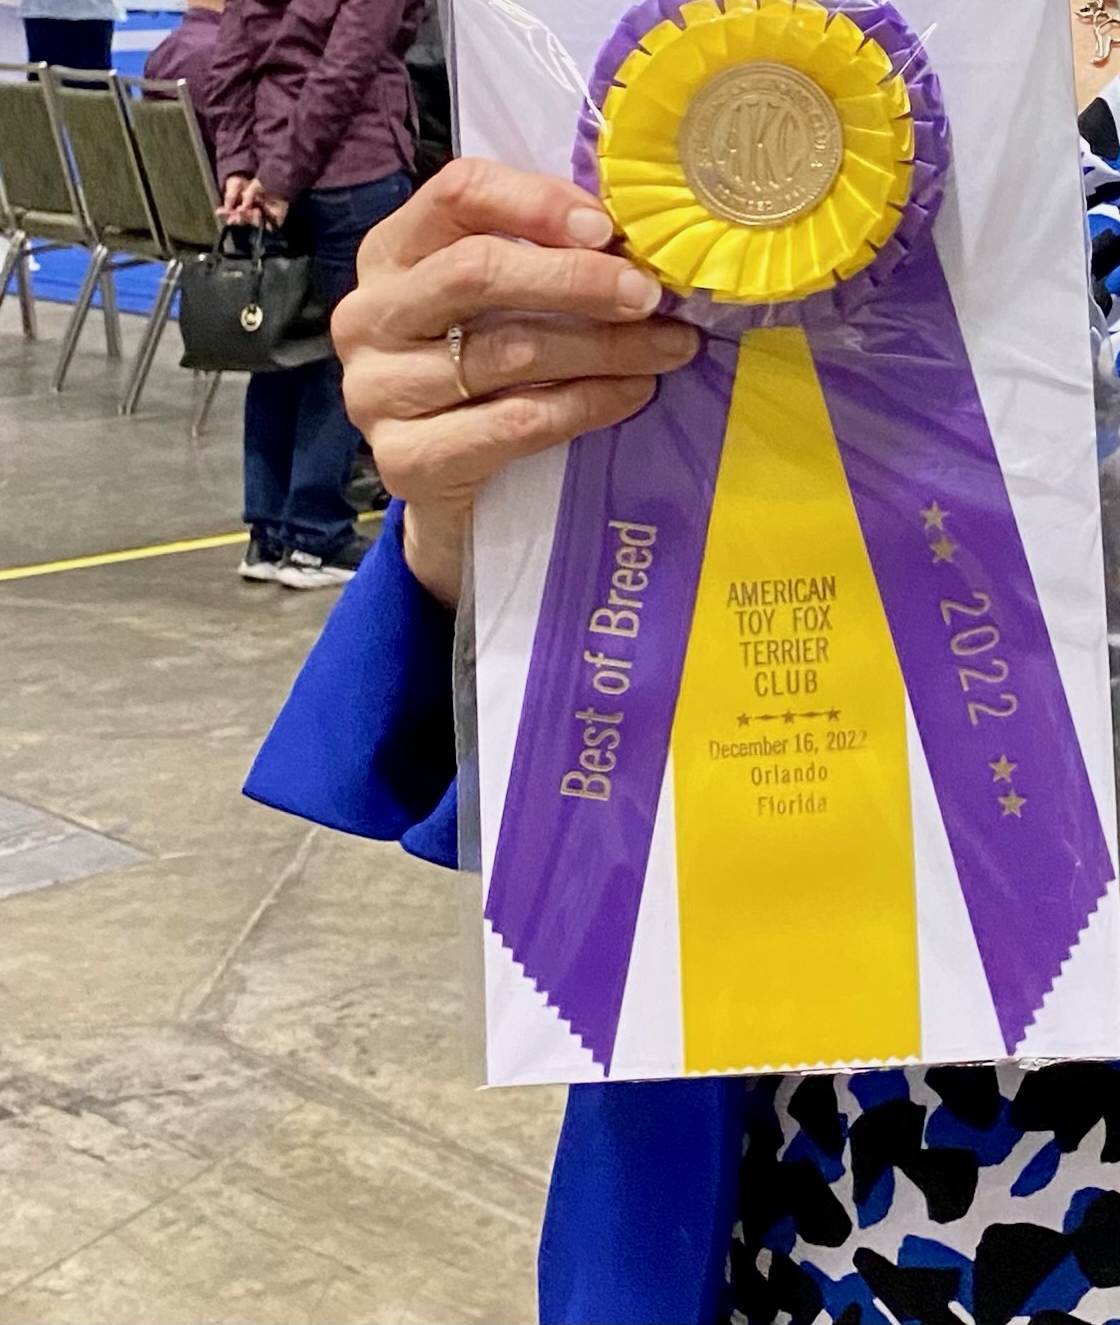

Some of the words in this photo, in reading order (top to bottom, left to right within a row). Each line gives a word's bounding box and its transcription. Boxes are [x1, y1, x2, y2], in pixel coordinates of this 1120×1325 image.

[589, 519, 657, 638] Breed
[727, 575, 837, 608] AMERICAN
[735, 608, 776, 636] TOY
[792, 605, 834, 632] FOX
[739, 636, 830, 667] TERRIER
[940, 590, 1018, 725] 2022
[583, 650, 633, 696] of
[755, 668, 819, 697] CLUB
[560, 707, 624, 801] Best
[709, 737, 788, 760] December
[794, 732, 819, 755] 16,
[826, 729, 867, 752] 2022
[751, 761, 828, 786] Orlando
[758, 792, 828, 817] Florida
